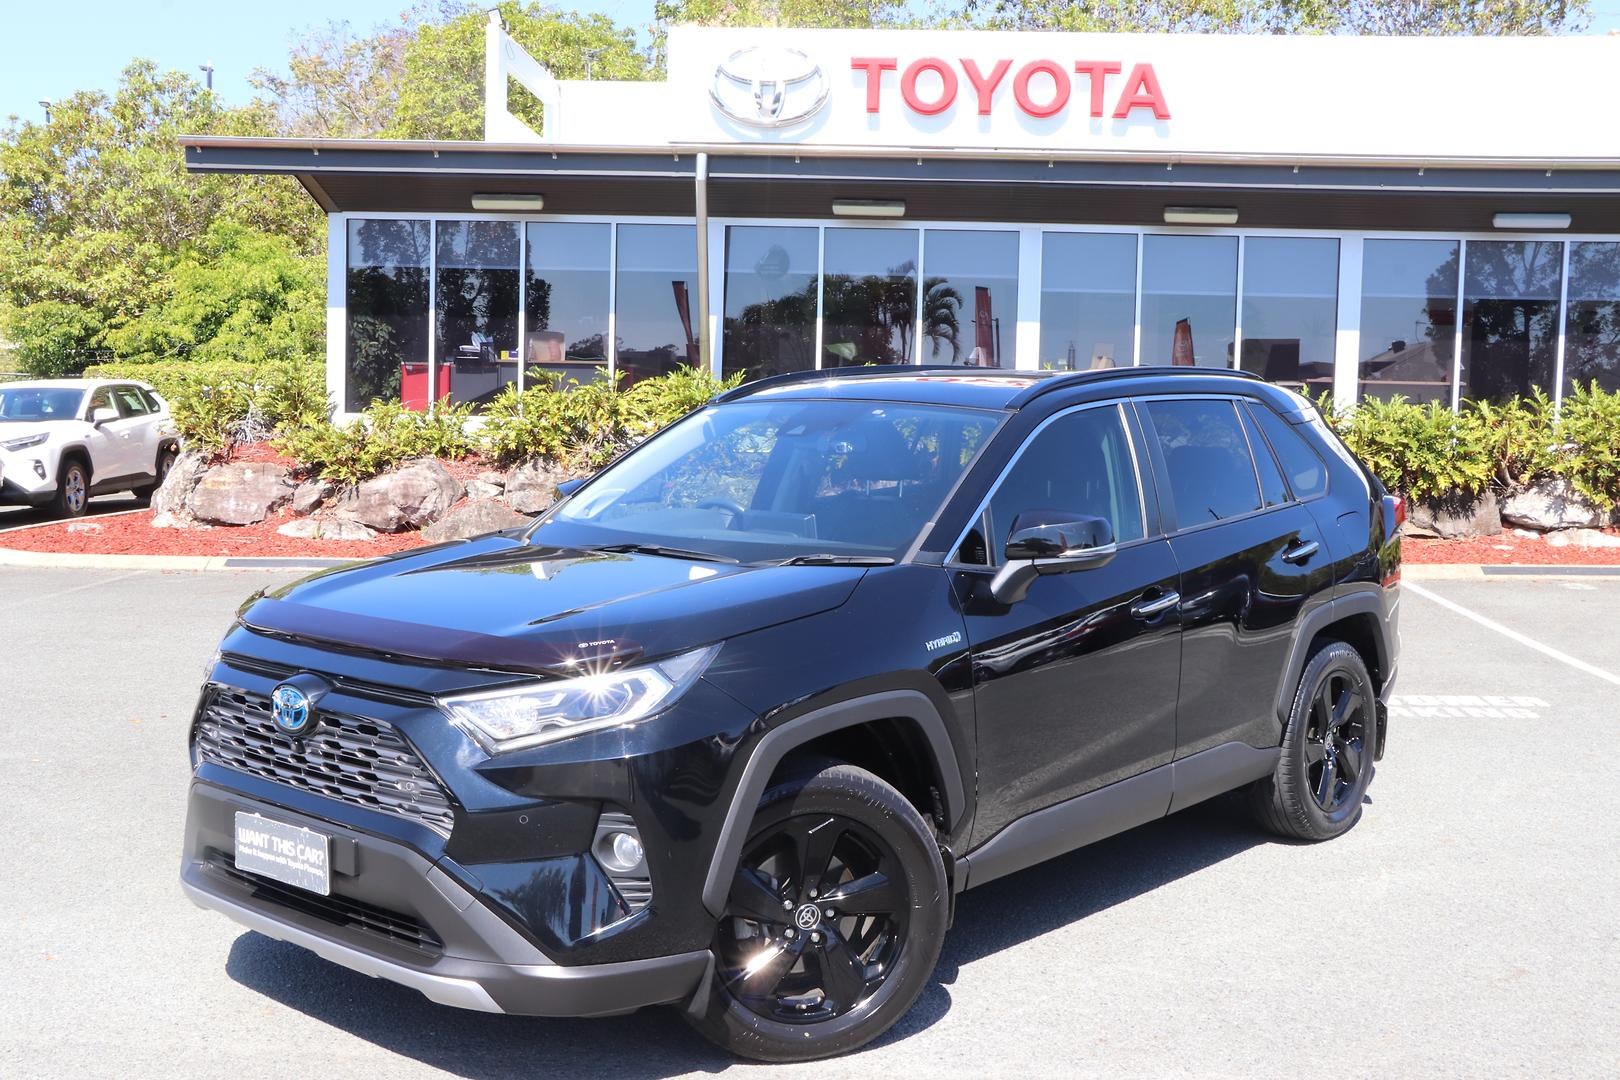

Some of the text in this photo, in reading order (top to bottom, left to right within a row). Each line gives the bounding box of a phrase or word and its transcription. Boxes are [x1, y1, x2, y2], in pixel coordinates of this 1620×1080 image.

[851, 57, 1171, 120] TOYOTA
[589, 639, 615, 647] TOYOTA
[925, 632, 960, 651] HYBRID
[1387, 694, 1551, 707] TOMER
[238, 827, 324, 866] WANT THIS CAR?
